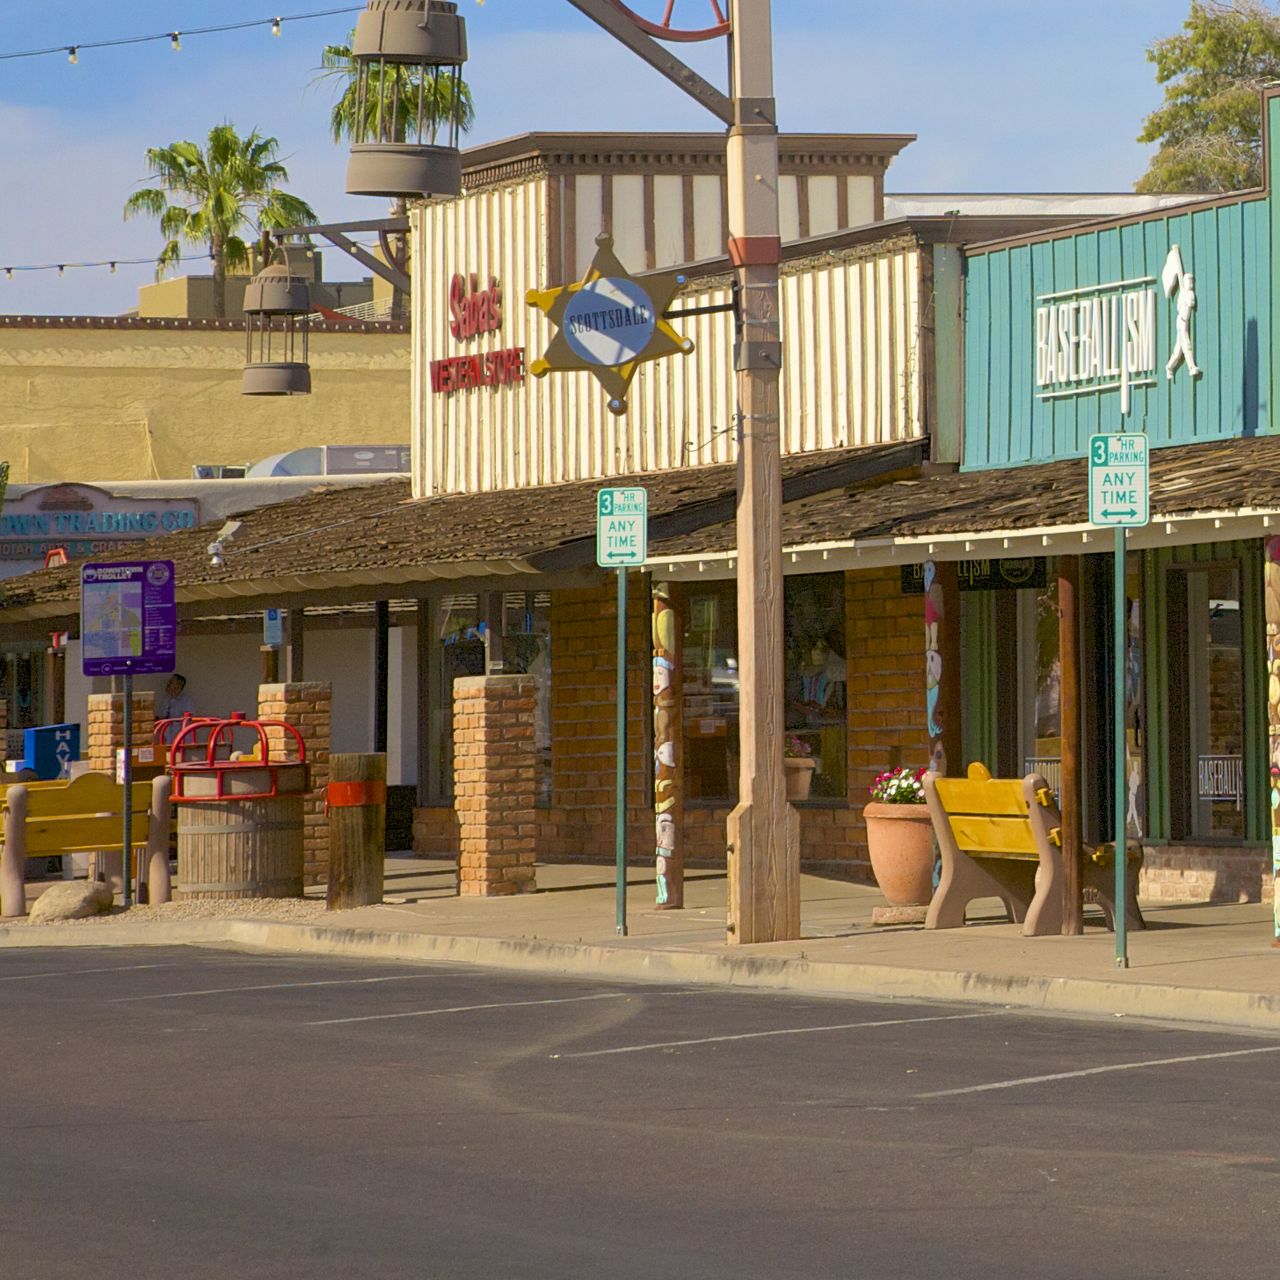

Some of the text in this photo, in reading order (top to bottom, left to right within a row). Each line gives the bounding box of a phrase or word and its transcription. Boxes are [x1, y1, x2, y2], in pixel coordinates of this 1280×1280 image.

[569, 304, 648, 336] SCOTTSDALE
[1036, 289, 1156, 414] BASEBALLISM
[429, 348, 523, 393] WESTERN STORE
[1093, 439, 1135, 464] 3 HR
[1109, 451, 1144, 463] PARKING
[1102, 471, 1136, 487] ANY
[601, 492, 635, 514] 3 HR
[1101, 490, 1137, 505] TIME
[614, 503, 643, 513] PARKING
[55, 510, 158, 534] TRADING
[608, 520, 636, 533] ANY
[607, 535, 637, 548] TIME
